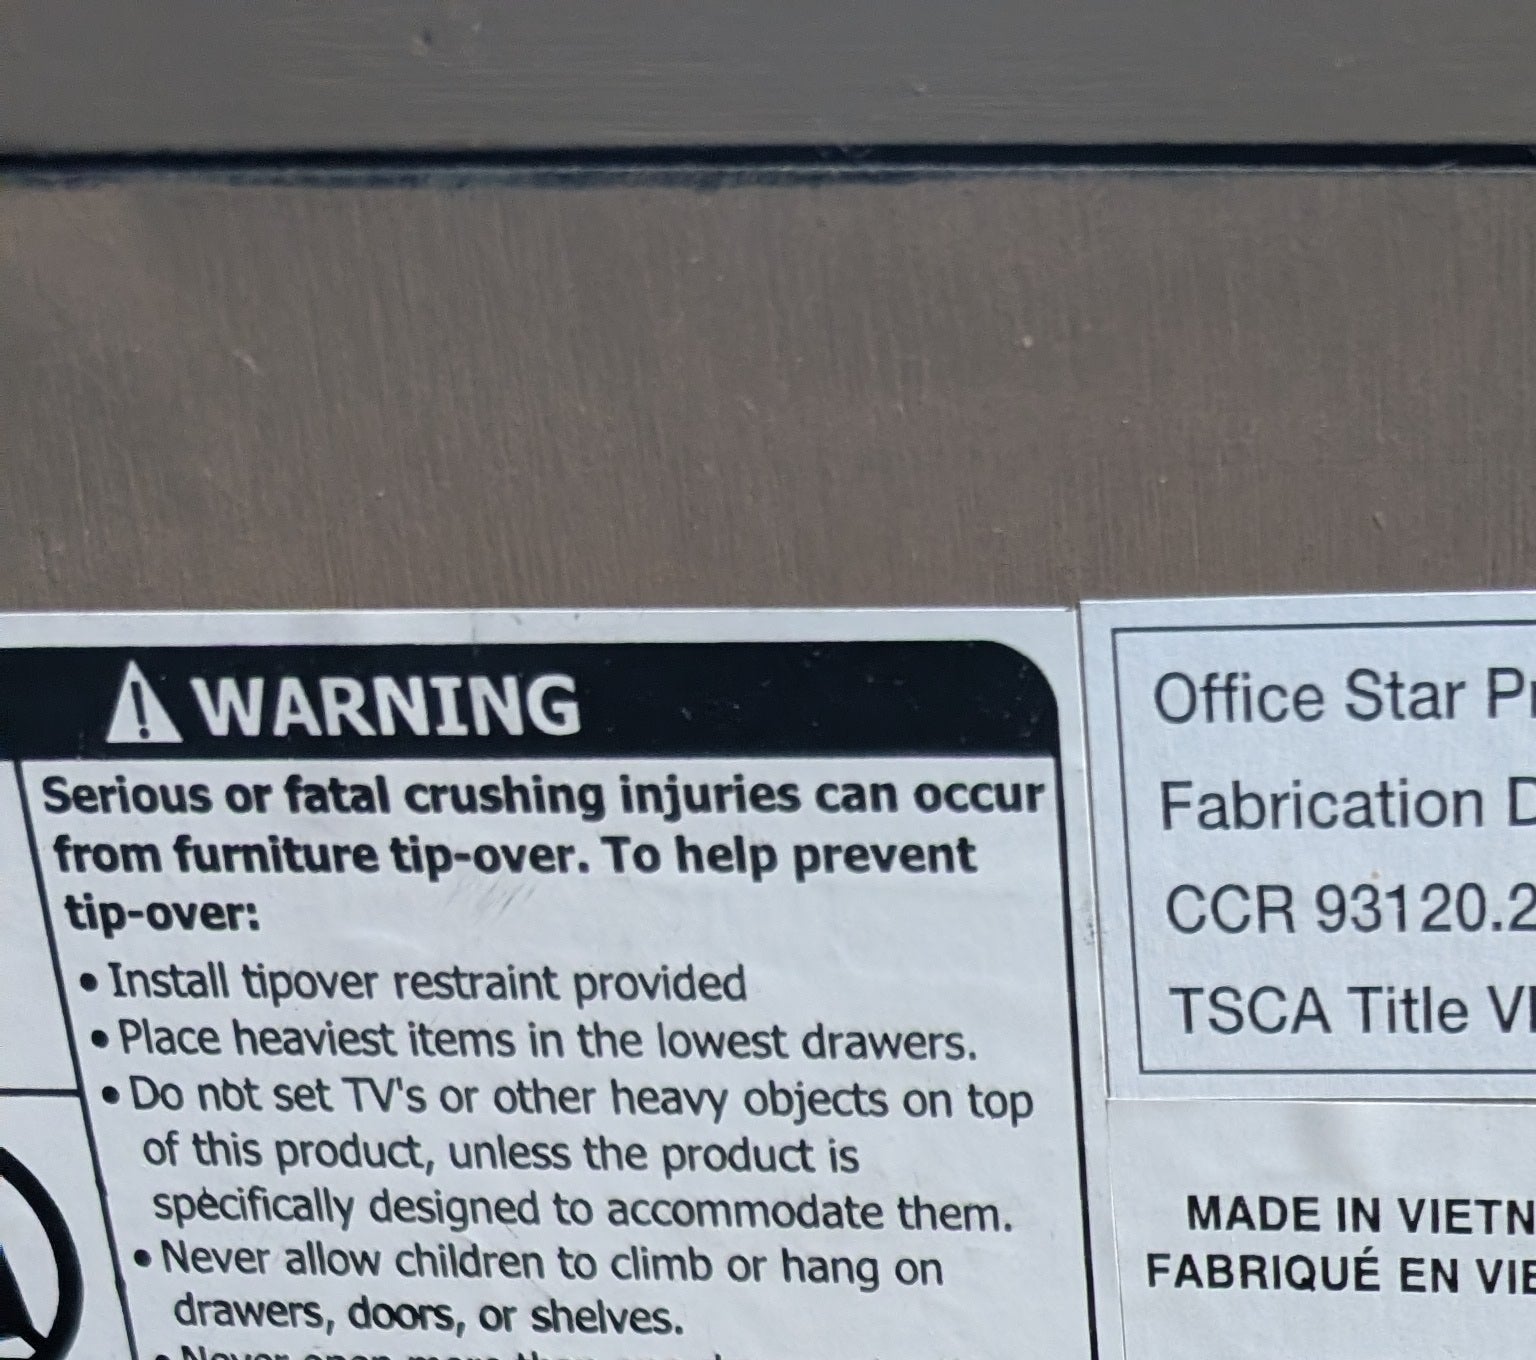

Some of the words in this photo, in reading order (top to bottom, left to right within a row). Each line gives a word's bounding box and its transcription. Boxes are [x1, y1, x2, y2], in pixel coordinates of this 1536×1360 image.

[190, 673, 581, 744] WARNING
[1153, 671, 1325, 725] Office
[1345, 667, 1467, 722] Star
[41, 774, 213, 814] Serious
[224, 783, 273, 814] or
[283, 773, 391, 814] fatal
[404, 773, 606, 822] crushing
[619, 773, 802, 823] injuries
[815, 782, 898, 813] can
[913, 782, 1046, 813] occur
[1160, 777, 1484, 831] Fabrication
[52, 833, 163, 873] from
[172, 833, 380, 874] furniture
[388, 834, 589, 883] tip-over.
[599, 835, 661, 874] To
[674, 834, 778, 883] help
[793, 836, 978, 883] prevent
[63, 891, 260, 940] tip-over:
[1166, 883, 1296, 935] CCR
[107, 960, 230, 999] Install
[240, 962, 379, 1008] tipover
[393, 963, 561, 1001] restraint
[573, 963, 747, 1010] provided
[1168, 984, 1332, 1035] TSCA
[1347, 985, 1469, 1034] Title
[117, 1017, 222, 1056] Place
[231, 1017, 398, 1057] heaviest
[407, 1020, 516, 1058] items
[528, 1021, 565, 1058] in
[576, 1020, 643, 1059] the
[656, 1021, 790, 1060] lowest
[801, 1021, 977, 1061] drawers.
[128, 1074, 184, 1111] Do
[196, 1076, 263, 1112] not
[272, 1077, 334, 1113] set
[340, 1076, 427, 1114] TV's
[439, 1084, 480, 1114] or
[493, 1077, 597, 1115] other
[609, 1077, 729, 1125] heavy
[743, 1079, 889, 1126] objects
[902, 1088, 953, 1118] on
[967, 1083, 1034, 1128] top
[1187, 1194, 1321, 1232] MADE
[1337, 1196, 1381, 1233] IN
[160, 1238, 271, 1275] Never
[284, 1239, 381, 1277] allow
[394, 1241, 545, 1279] children
[556, 1246, 598, 1280] to
[610, 1245, 713, 1281] climb
[726, 1254, 768, 1282] or
[781, 1246, 880, 1293] hang
[894, 1257, 944, 1286] on
[1146, 1245, 1381, 1292] FABRIQUÉ
[1399, 1256, 1459, 1294] EN
